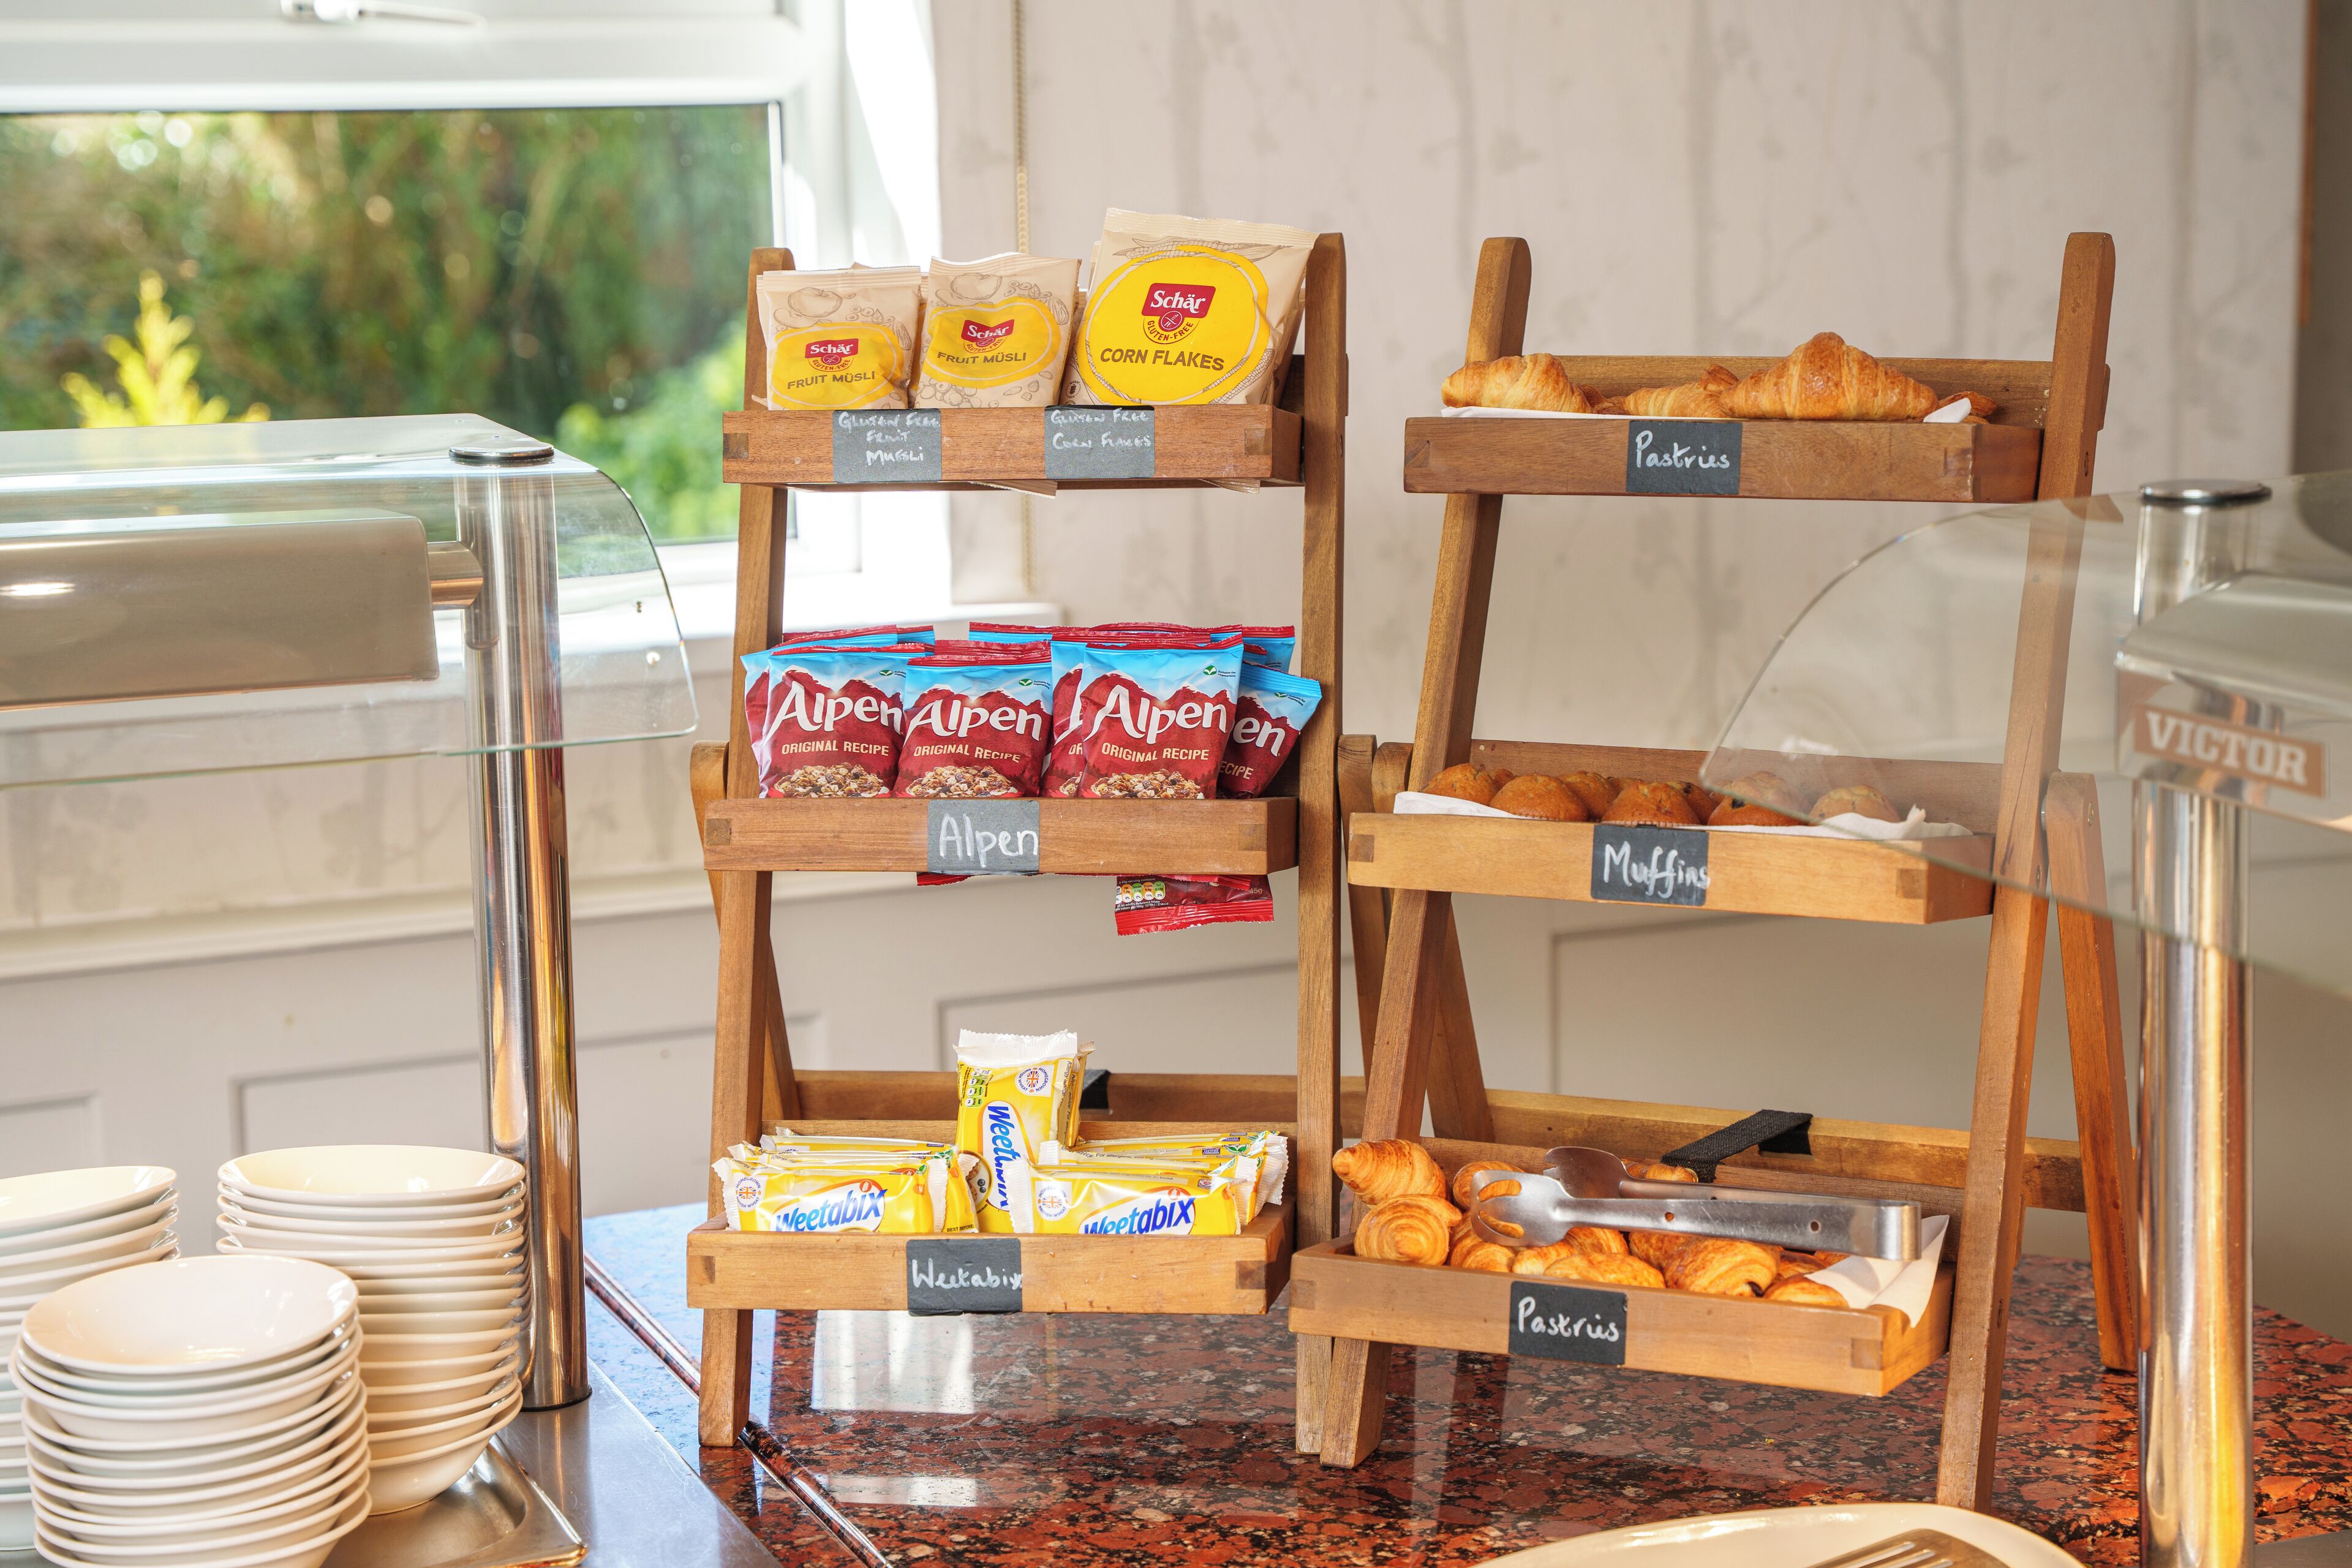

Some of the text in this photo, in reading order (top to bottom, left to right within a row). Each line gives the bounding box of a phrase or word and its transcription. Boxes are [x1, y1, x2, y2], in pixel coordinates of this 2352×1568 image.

[1150, 289, 1206, 314] Schär
[967, 325, 1009, 339] Schär
[1147, 320, 1194, 341] GLUTEN-FREE
[810, 343, 854, 355] Schär
[967, 338, 1003, 352] GLUTEN-FREE
[812, 358, 850, 371] GLUTEN-FREE
[937, 352, 1027, 364] FRUIT MÜSLI
[1100, 348, 1225, 371] CORN FLAKES
[787, 371, 875, 390] FRUIT MÜSLI
[1635, 430, 1730, 469] Pastries
[762, 680, 903, 745] Alpen
[1083, 684, 1227, 745] Alpen
[902, 699, 1042, 748] Alpen
[782, 740, 889, 756] ORIGINAL RECIPE
[913, 744, 1021, 763] ORIGINAL RECIPE
[1101, 742, 1158, 763] ORIGINAL
[1163, 748, 1210, 761] RECIPE
[2147, 711, 2308, 786] VICTOR
[1219, 761, 1254, 780] ECIPE
[939, 813, 1039, 868] Alpen
[1604, 840, 1711, 899] Muffins
[1018, 1079, 1028, 1091] WHEAT
[1035, 1067, 1049, 1092] HOMEGROWN
[736, 1177, 761, 1189] HOMEGROWN
[747, 1196, 760, 1208] WHEAT
[776, 1189, 888, 1232] Weetabix
[1052, 1206, 1066, 1218] WHEAT
[1084, 1197, 1196, 1234] Weetabix
[1518, 1296, 1619, 1342] Pastries
